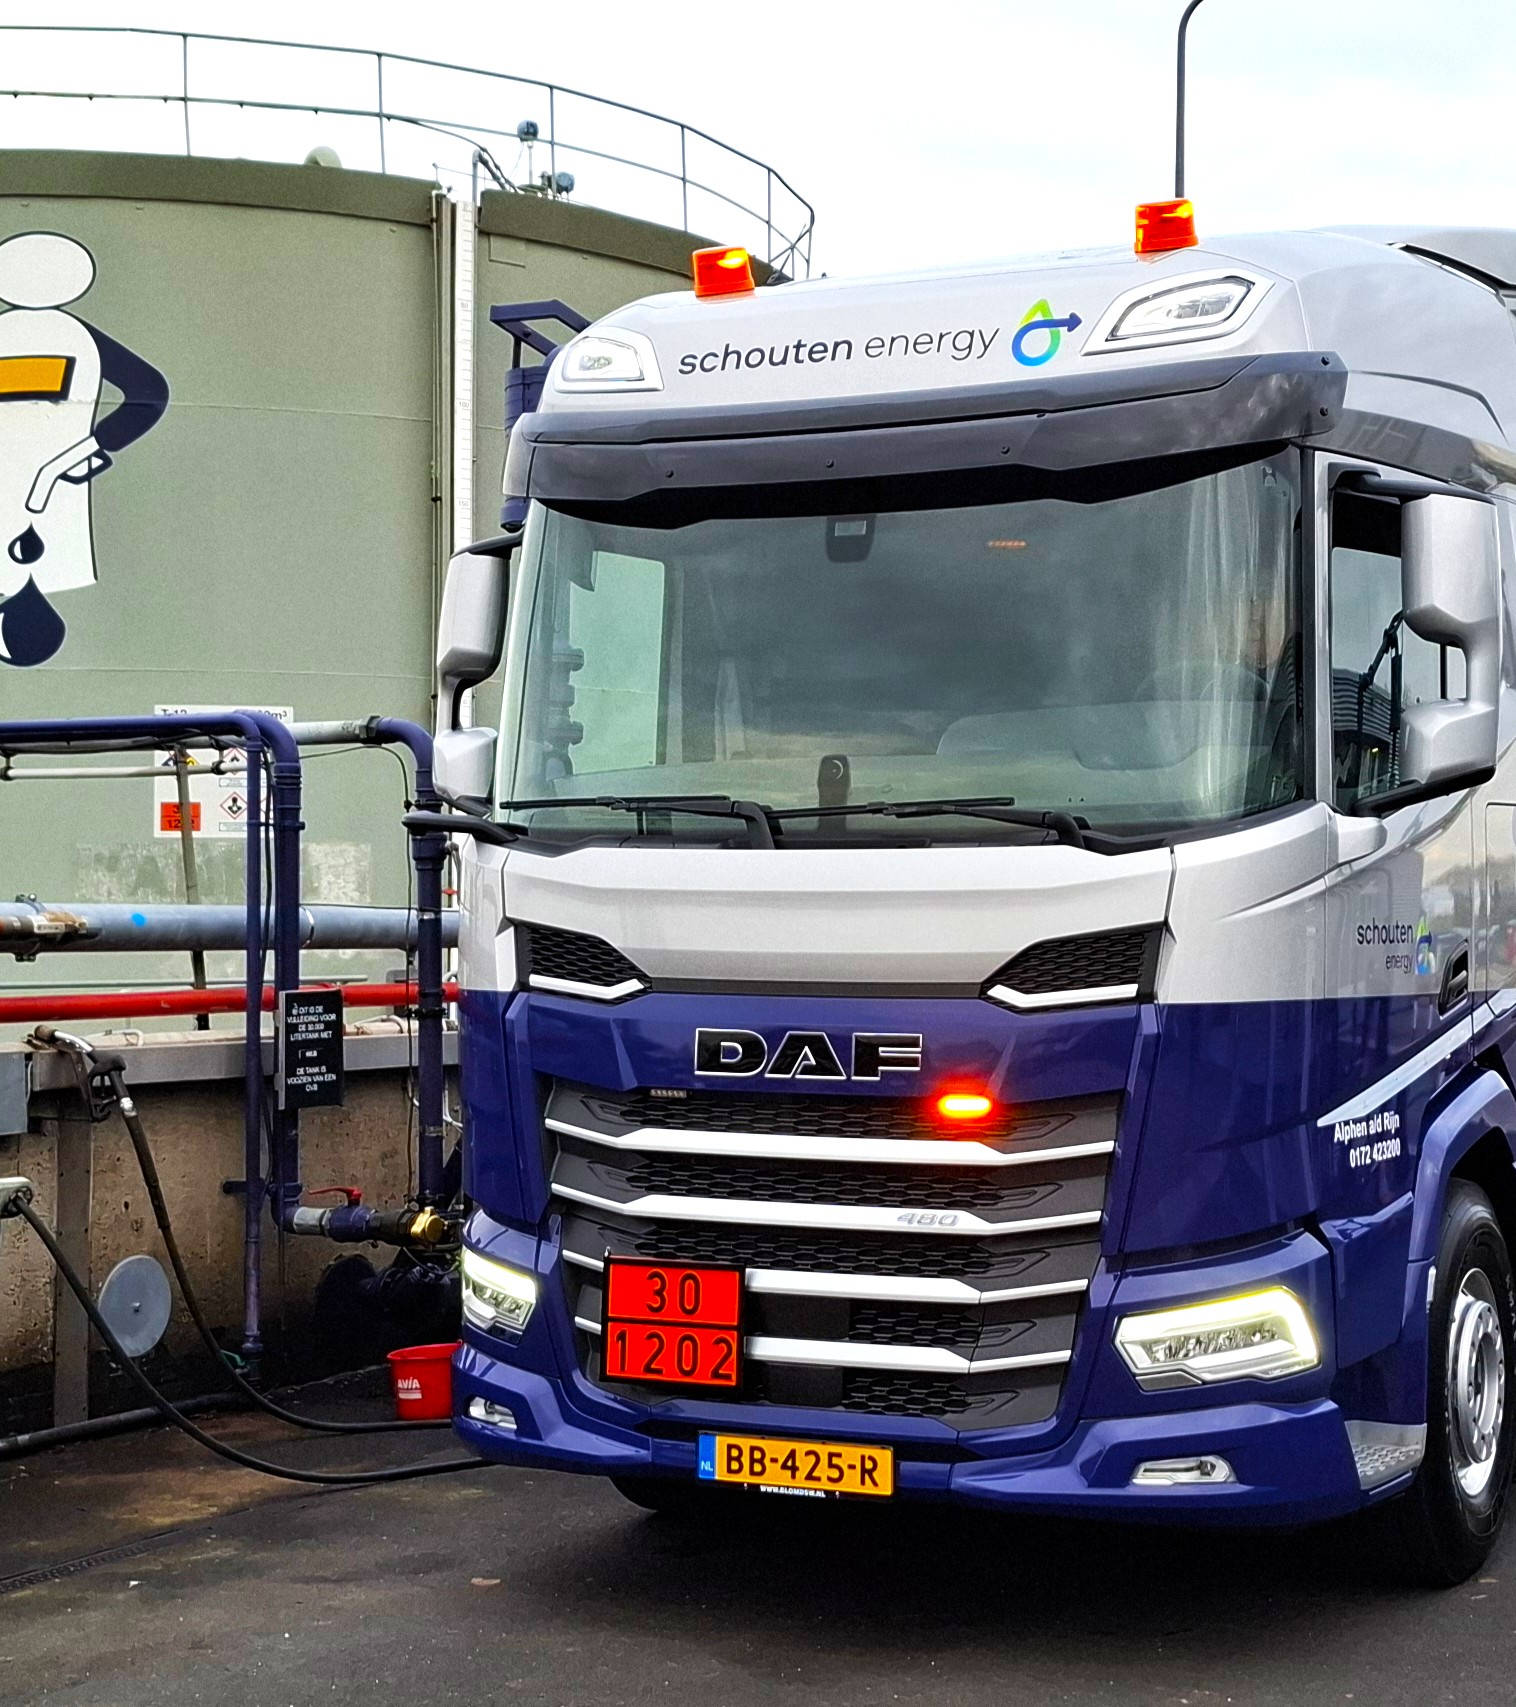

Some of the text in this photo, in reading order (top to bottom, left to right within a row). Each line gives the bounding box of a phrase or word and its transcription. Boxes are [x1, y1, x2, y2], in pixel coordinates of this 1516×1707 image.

[678, 326, 1000, 375] schouten energy
[1357, 917, 1414, 945] schouten
[1385, 955, 1413, 974] energy
[320, 1013, 336, 1021] VOOR
[694, 1027, 923, 1081] DAF
[1333, 1119, 1368, 1145] Alphen
[1383, 1110, 1400, 1134] Rijn
[1349, 1137, 1401, 1168] 0172 423200
[896, 1212, 960, 1227] 480
[645, 1268, 702, 1315] 30
[615, 1328, 733, 1380] 1202
[397, 1376, 421, 1389] AVIA
[700, 1443, 879, 1487] NL BB-425-R
